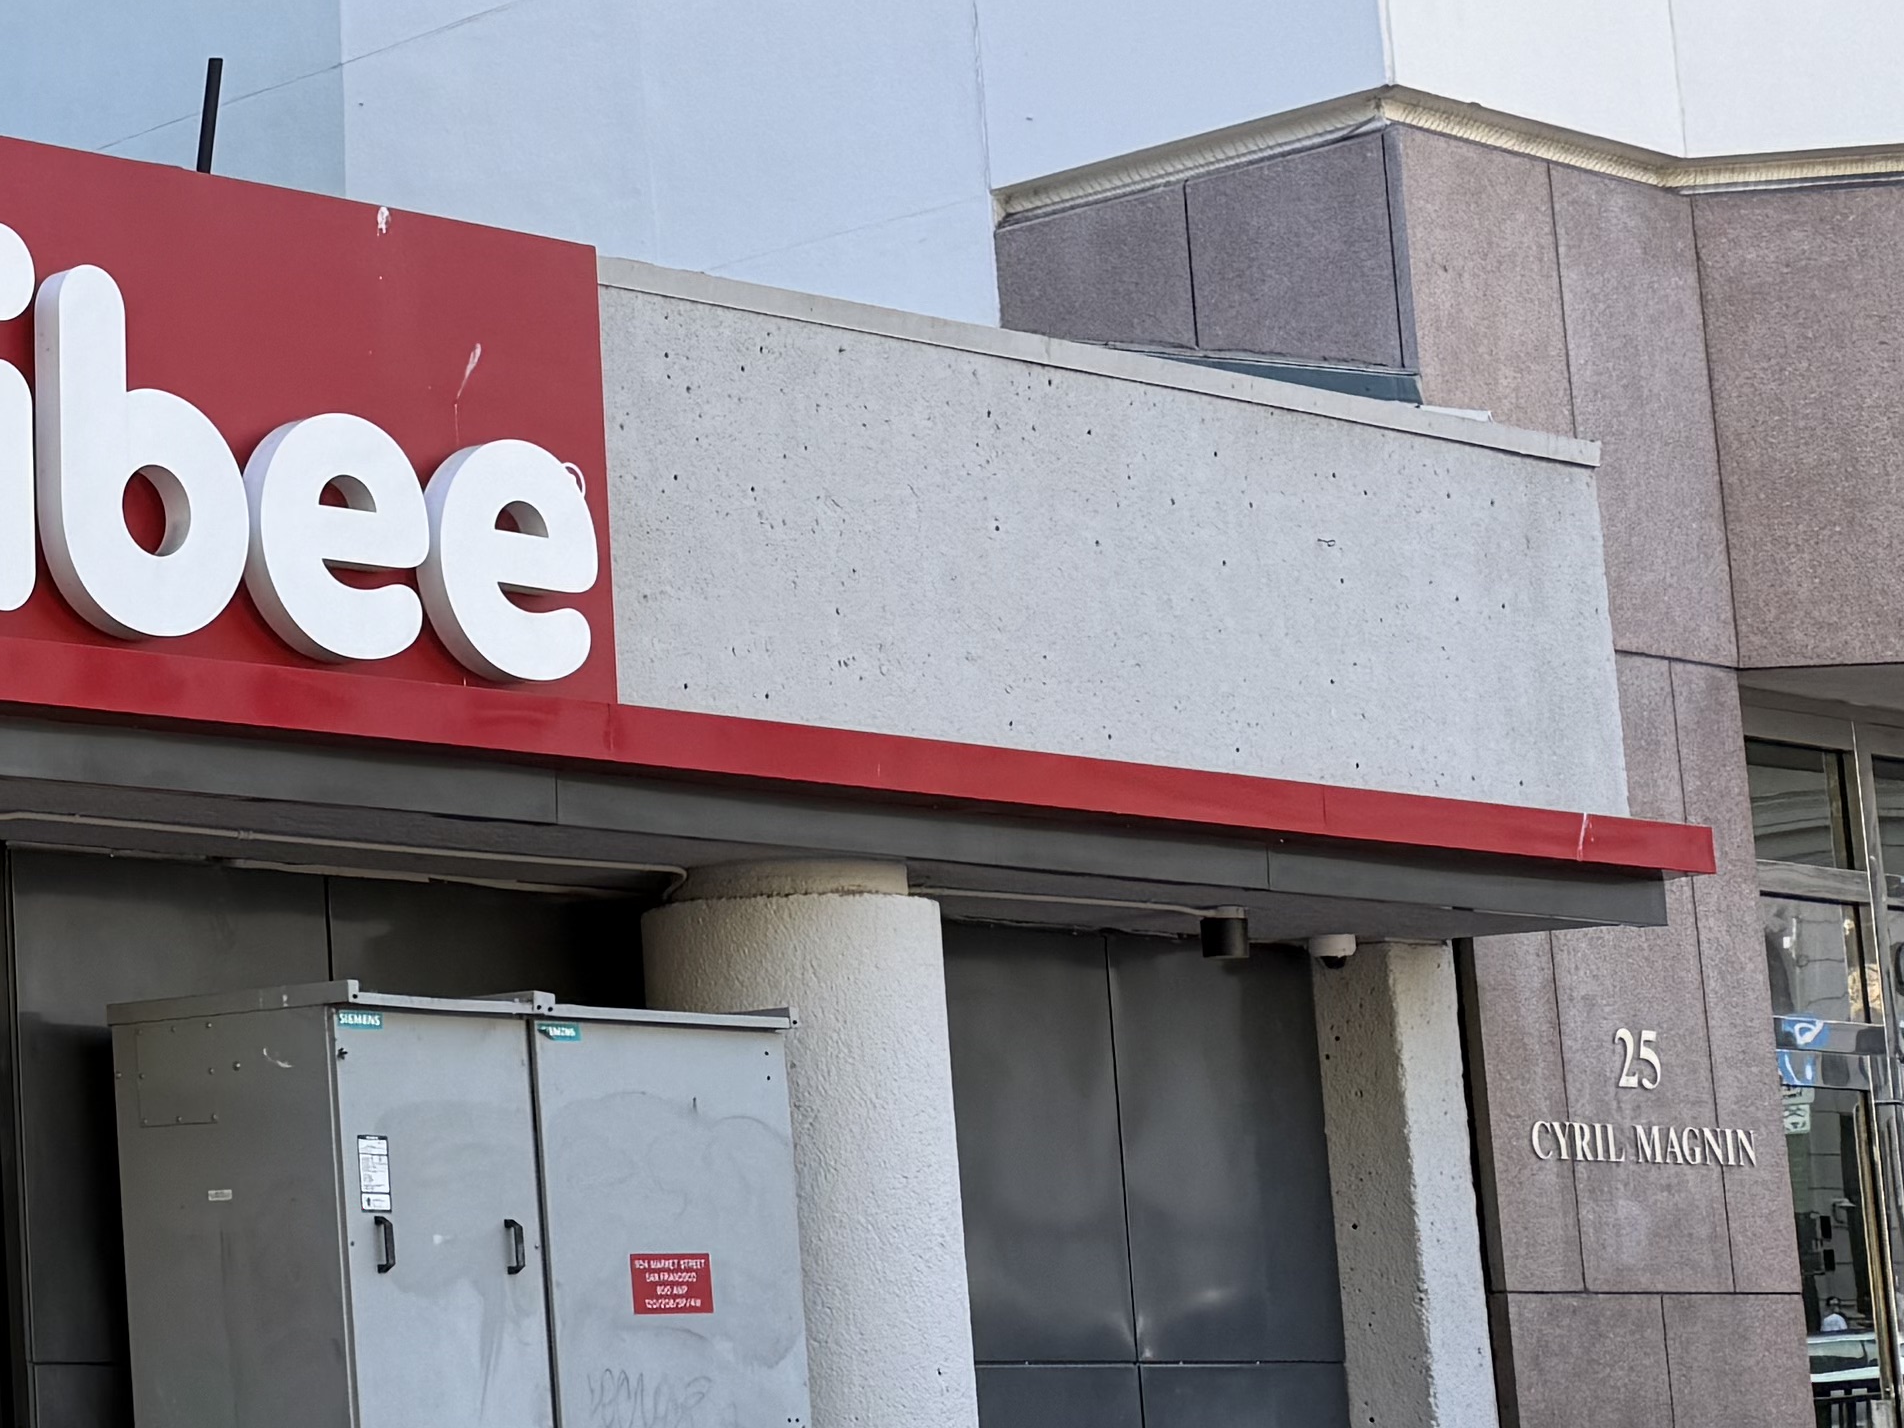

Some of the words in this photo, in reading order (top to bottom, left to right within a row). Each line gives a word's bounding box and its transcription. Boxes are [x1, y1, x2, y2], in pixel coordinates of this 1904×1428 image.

[339, 1013, 381, 1026] SIEMENS
[1614, 1027, 1662, 1090] 25
[1531, 1120, 1625, 1163] CYRIL
[1633, 1125, 1758, 1168] MAGNIN
[680, 1259, 705, 1269] STREET
